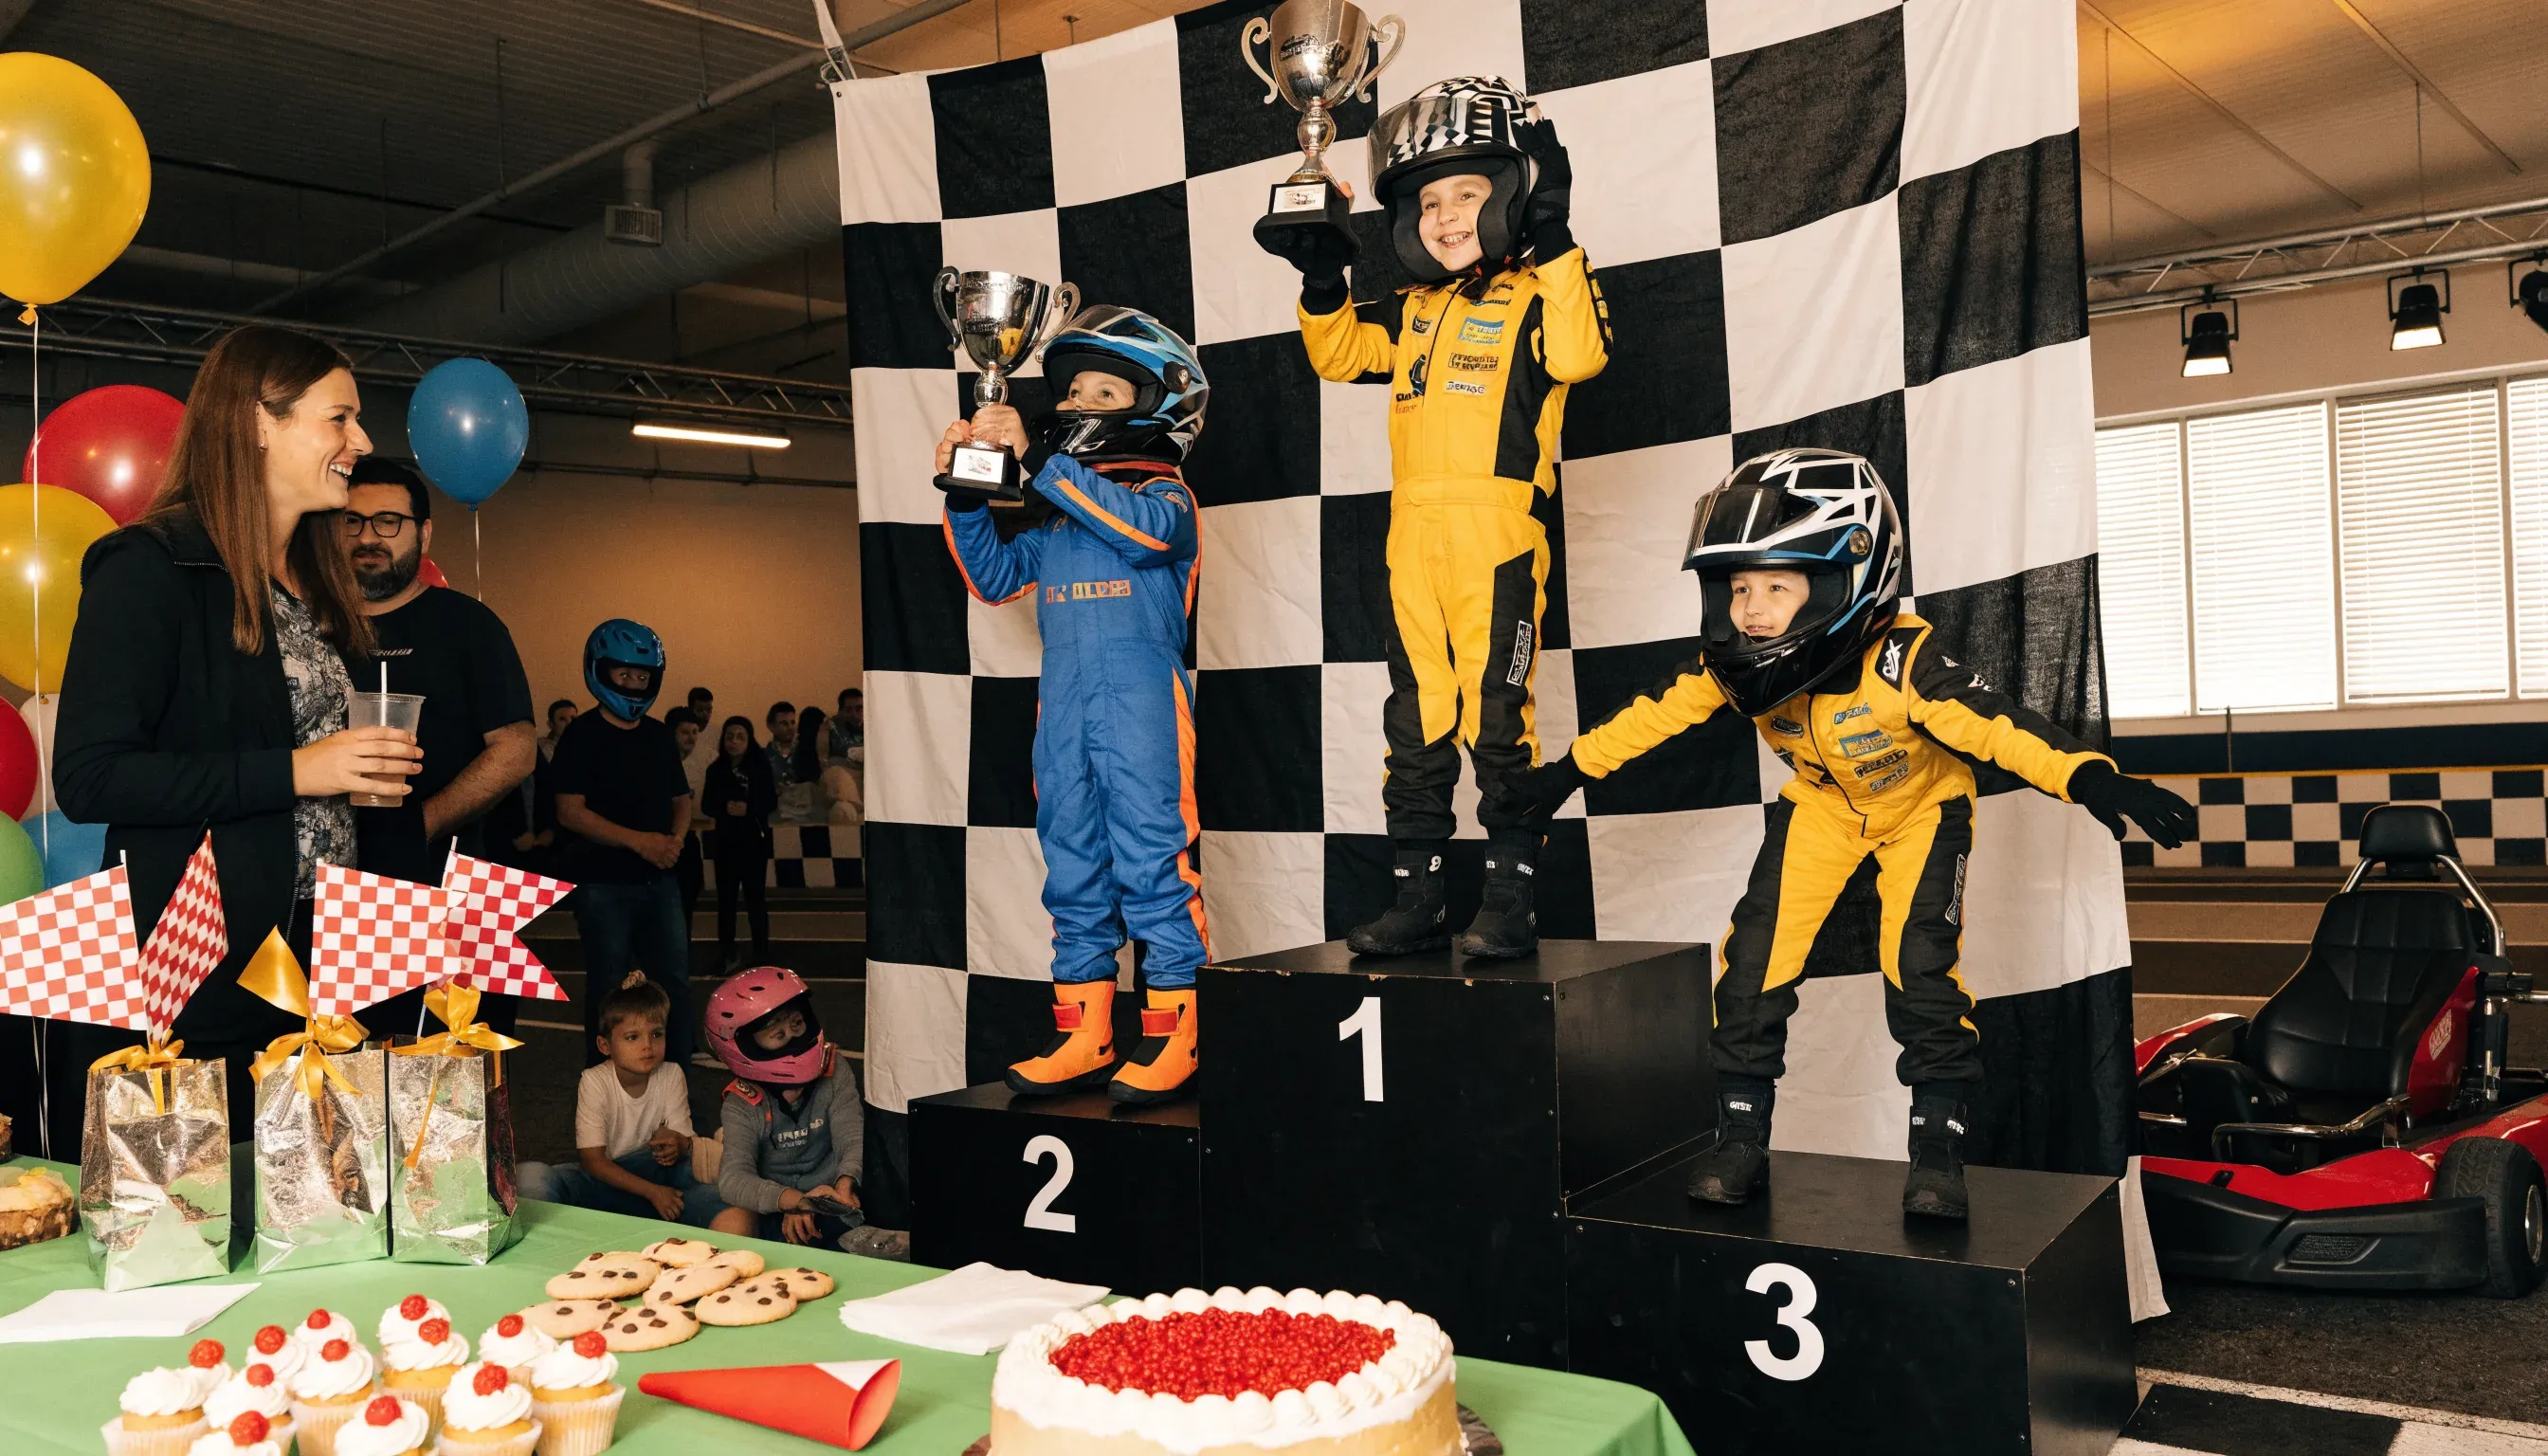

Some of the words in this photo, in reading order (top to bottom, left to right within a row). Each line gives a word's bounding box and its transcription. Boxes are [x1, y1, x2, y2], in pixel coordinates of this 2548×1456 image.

[1339, 997, 1383, 1101] 1
[1023, 1136, 1075, 1233] 2
[1744, 1263, 1824, 1380] 3
